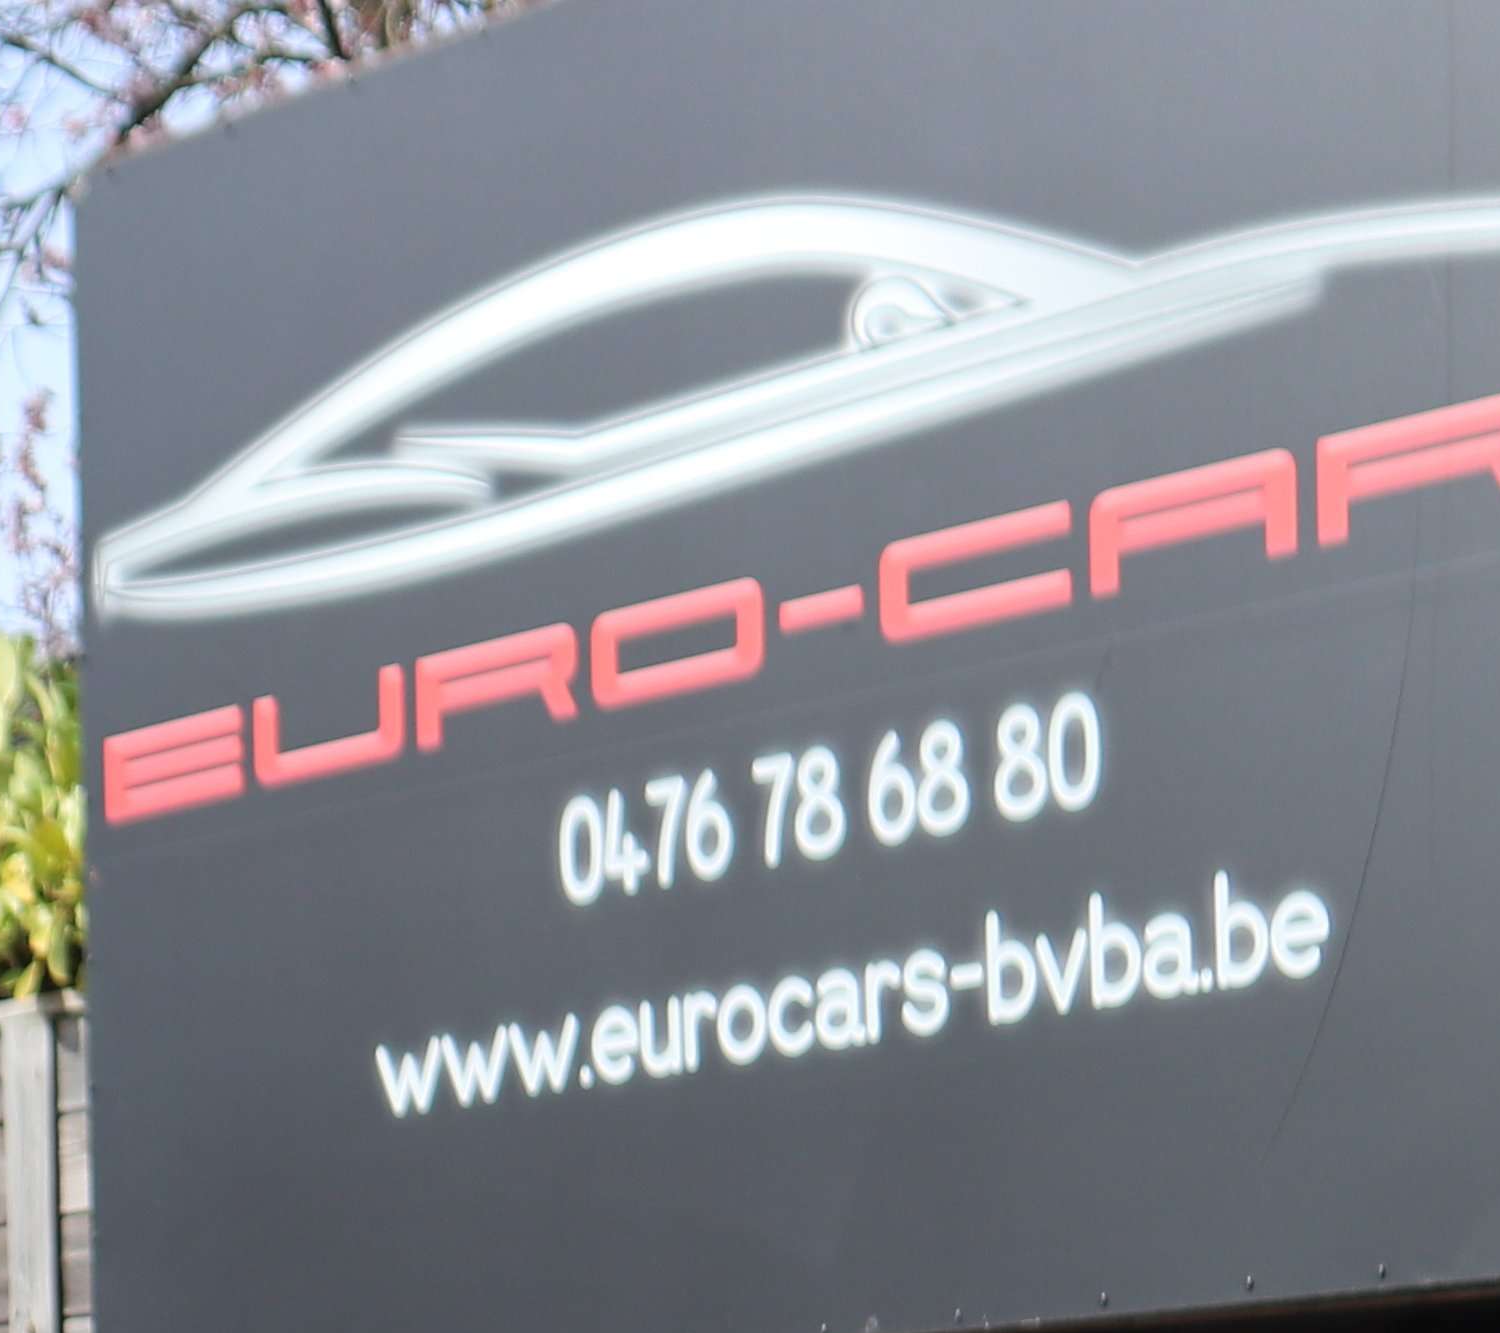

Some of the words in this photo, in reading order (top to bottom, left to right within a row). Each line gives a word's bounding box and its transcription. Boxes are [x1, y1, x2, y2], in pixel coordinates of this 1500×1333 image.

[557, 767, 735, 907] 0476
[750, 744, 848, 870] 78
[865, 717, 971, 848] 68
[992, 689, 1102, 824] 80
[373, 871, 1332, 1118] www.eurocars-bvba.be
